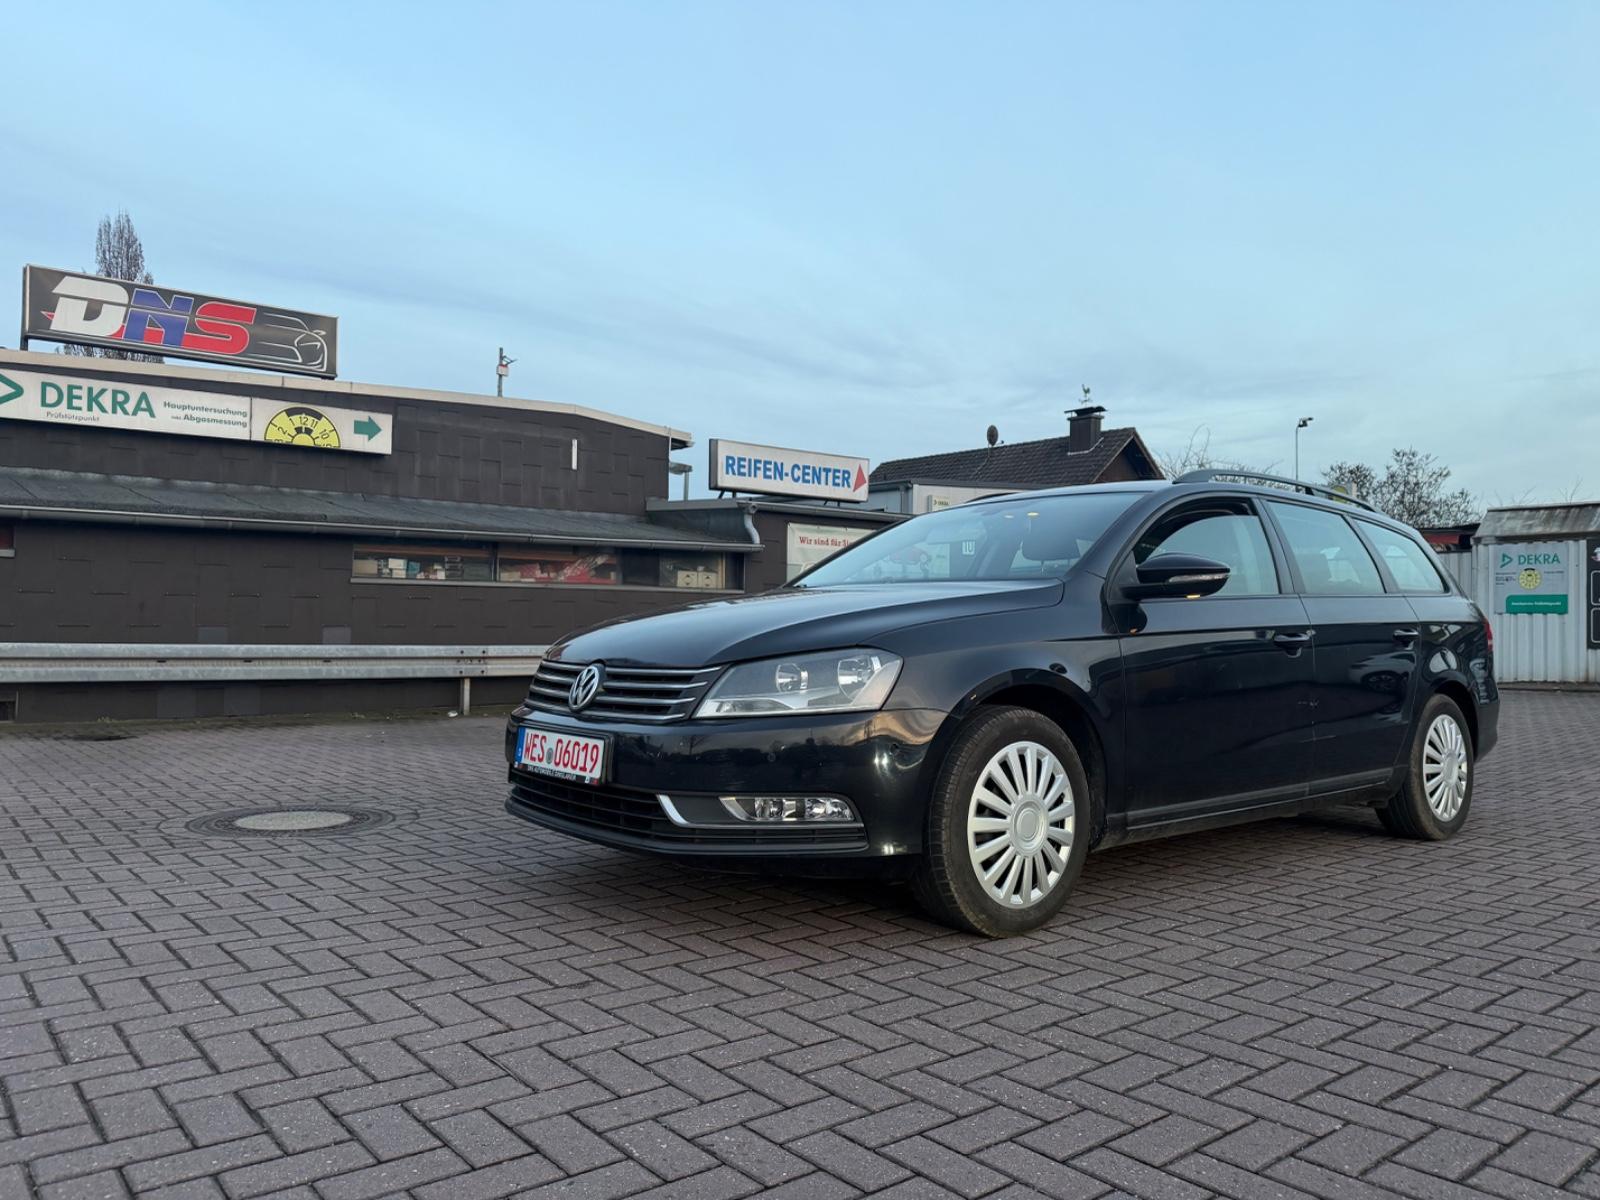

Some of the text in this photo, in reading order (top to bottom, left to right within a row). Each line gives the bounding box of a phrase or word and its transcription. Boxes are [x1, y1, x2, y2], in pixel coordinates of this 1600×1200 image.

[48, 275, 257, 355] DNS
[40, 381, 156, 419] DEKRA
[163, 401, 248, 418] Hauptuntersuchung
[183, 414, 248, 428] Abgasmessung
[725, 455, 851, 488] REIFEN-CENTER
[799, 536, 812, 545] Wir
[814, 537, 829, 546] sind
[1518, 553, 1561, 565] DEKRA
[524, 732, 600, 774] WES 06019
